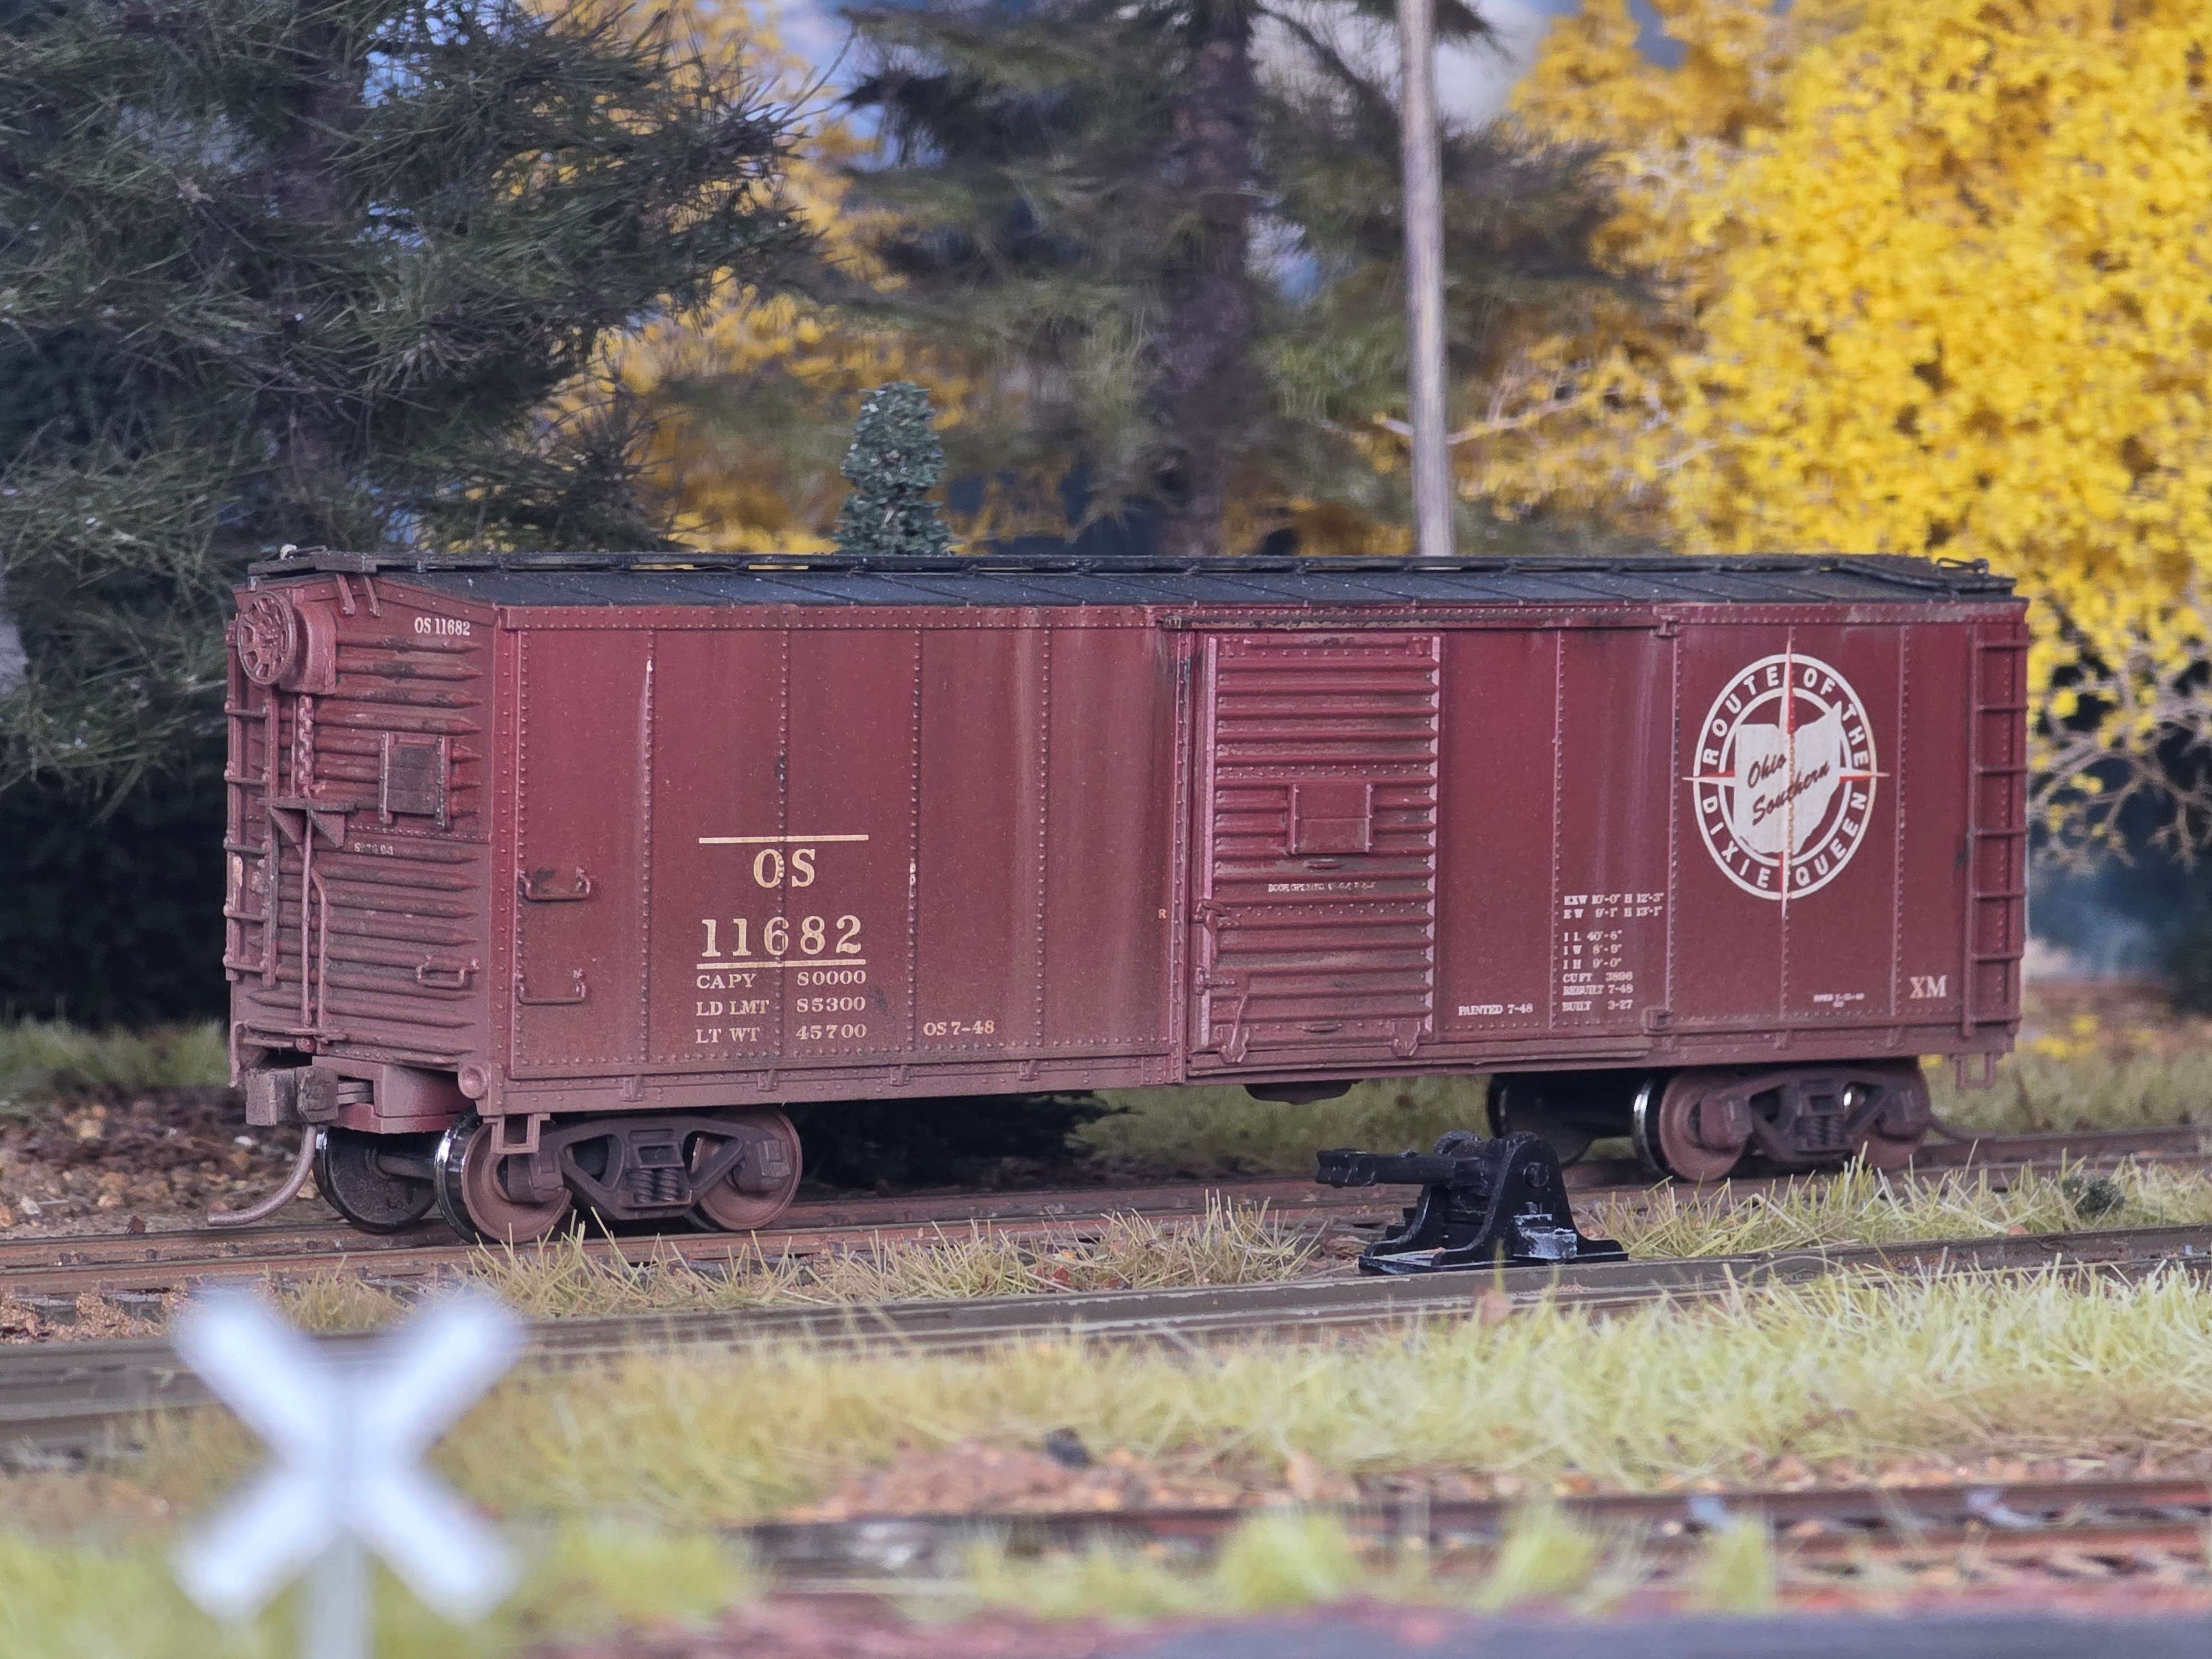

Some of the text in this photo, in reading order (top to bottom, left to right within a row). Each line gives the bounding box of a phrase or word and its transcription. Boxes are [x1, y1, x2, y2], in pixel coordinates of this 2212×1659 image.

[414, 617, 471, 636] OS 11682
[1703, 666, 1869, 767] ROUTE OF THE
[1747, 753, 1787, 789] Ohio
[1752, 760, 1830, 826] Southern
[1703, 792, 1867, 888] DIXIE QUEEN
[753, 848, 816, 888] OS
[701, 915, 862, 957] 11682
[696, 969, 867, 989] CAPY 80000
[1909, 974, 1947, 999] XM
[696, 996, 866, 1016] LD LMT 85300
[1458, 1003, 1533, 1016] PAINTED 7-48
[695, 1023, 867, 1044] LT WT 45700
[923, 1019, 995, 1036] OS 7-48
